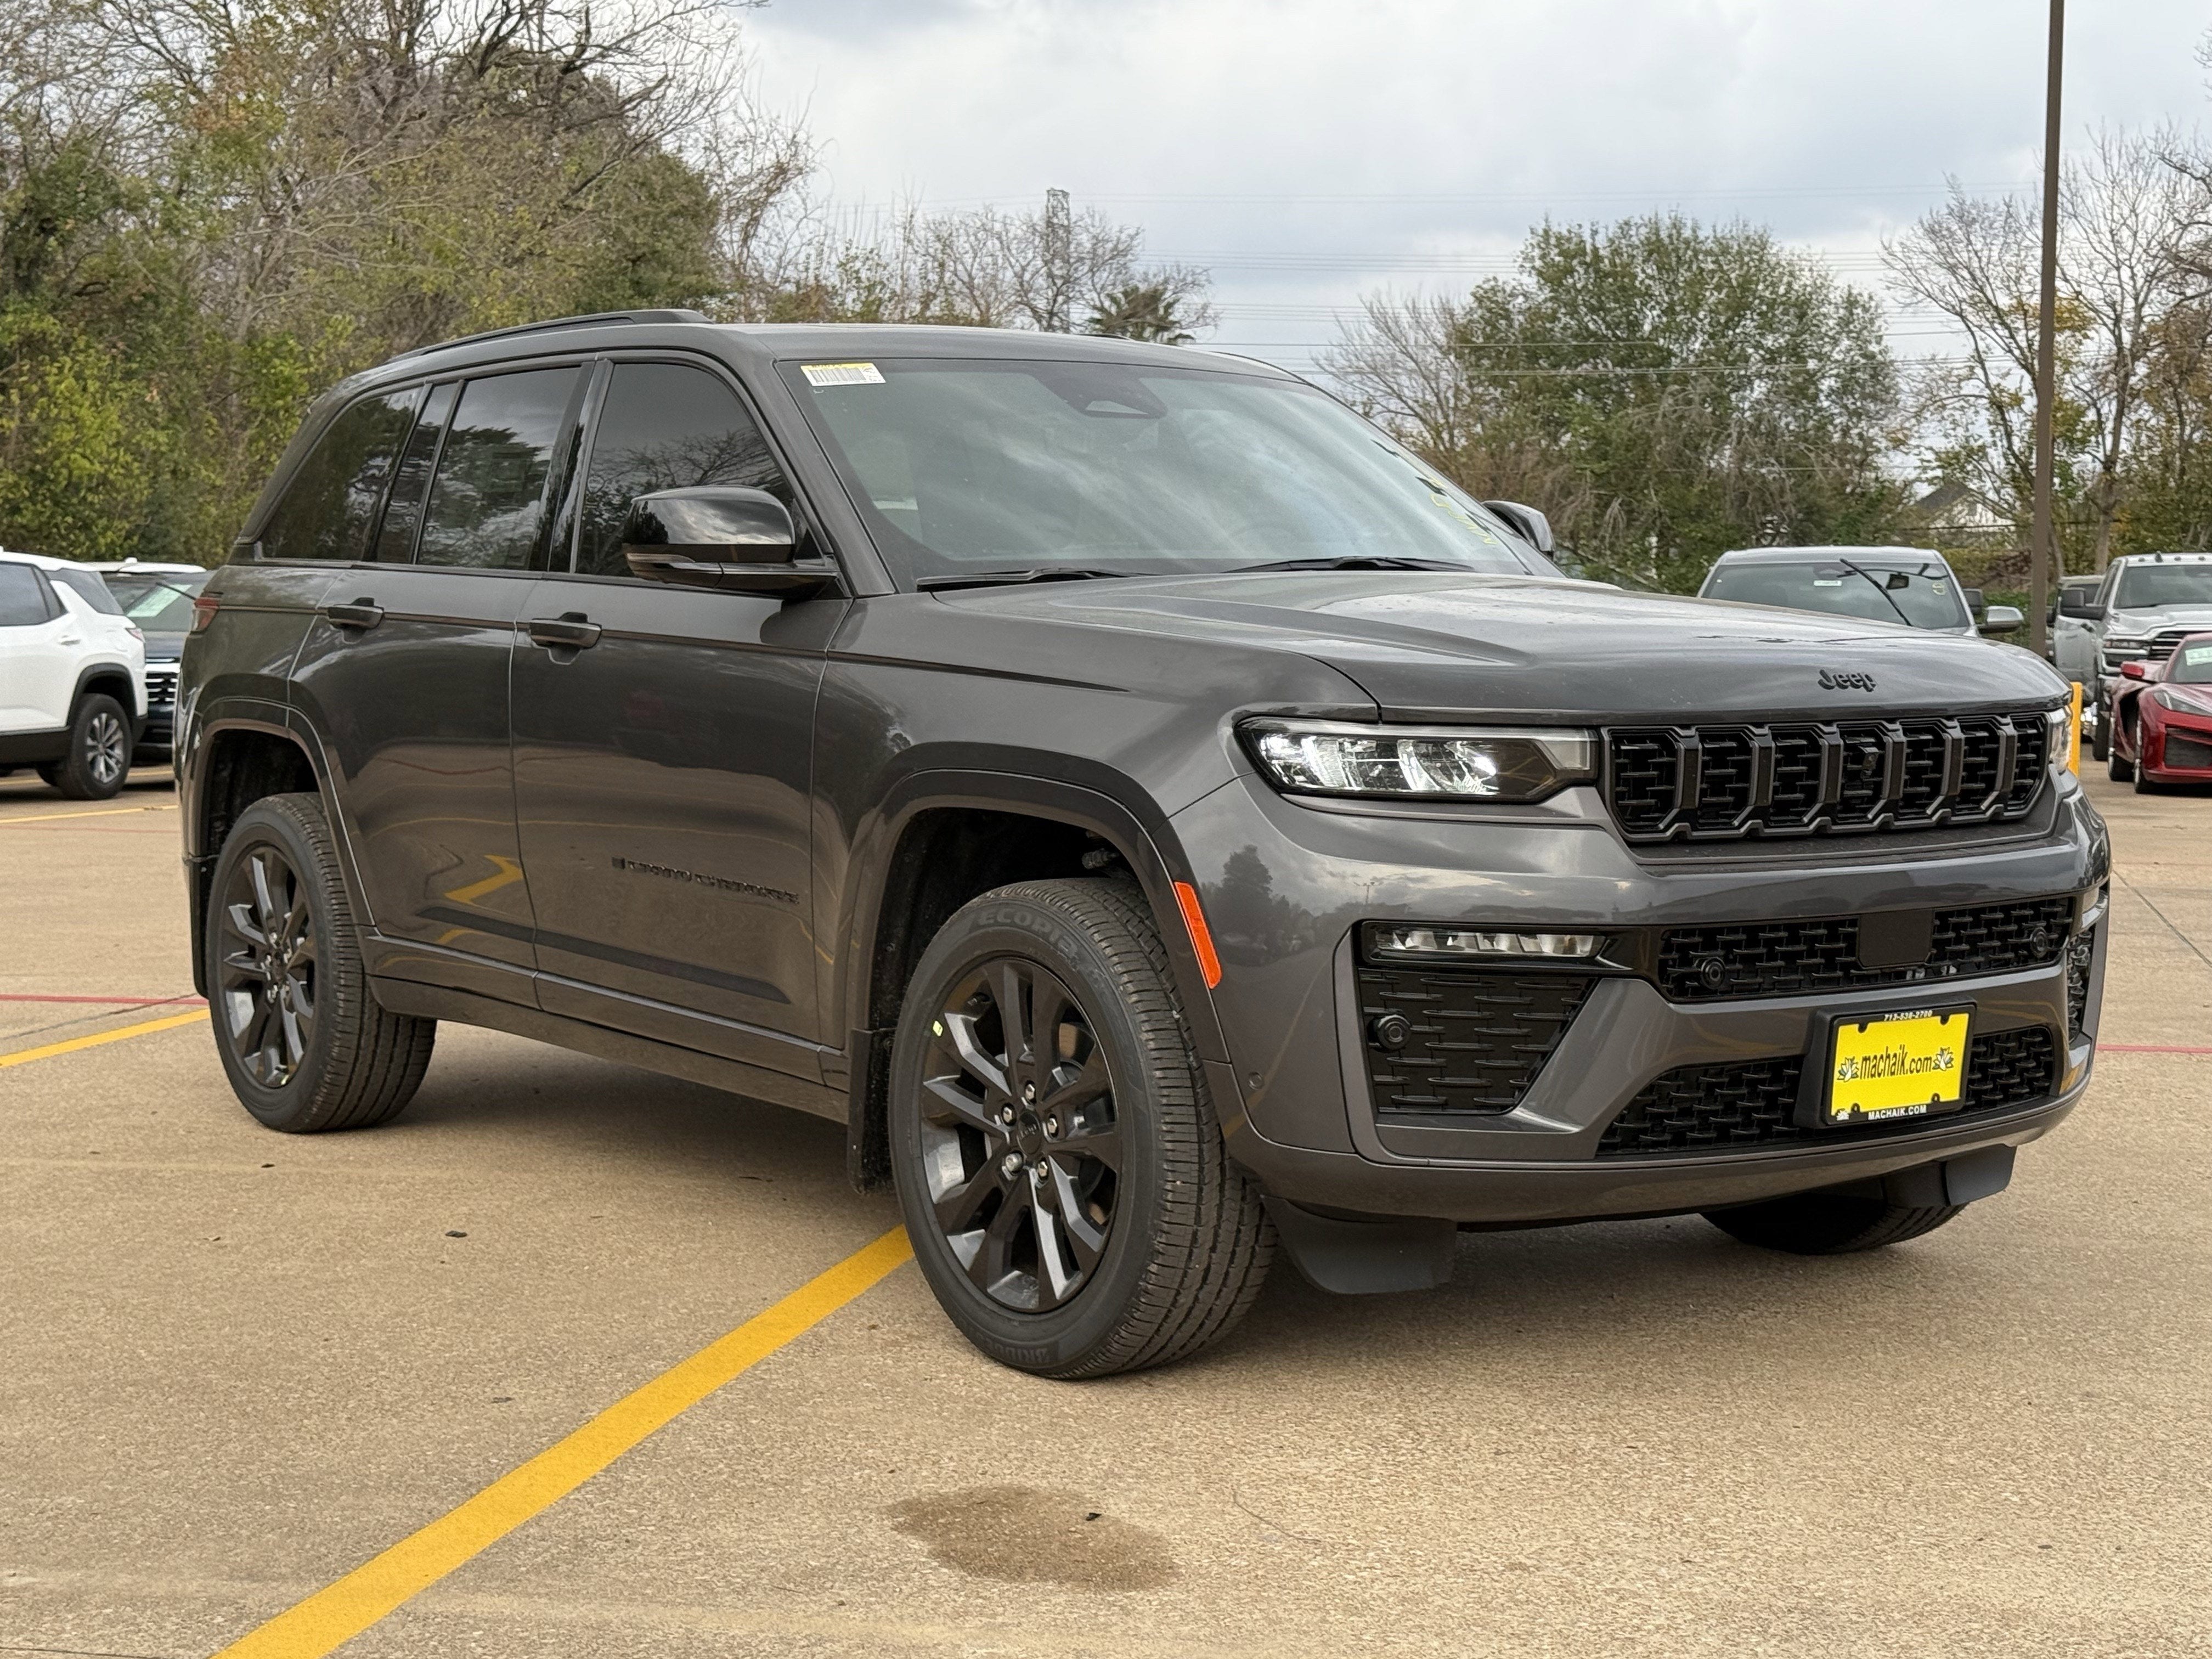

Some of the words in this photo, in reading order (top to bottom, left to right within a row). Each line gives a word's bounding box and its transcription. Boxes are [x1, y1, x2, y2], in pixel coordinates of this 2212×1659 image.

[1818, 669, 1876, 692] Jeep
[1860, 1044, 1932, 1080] machaik.com
[1867, 1104, 1927, 1120] MACHAIK.COM
